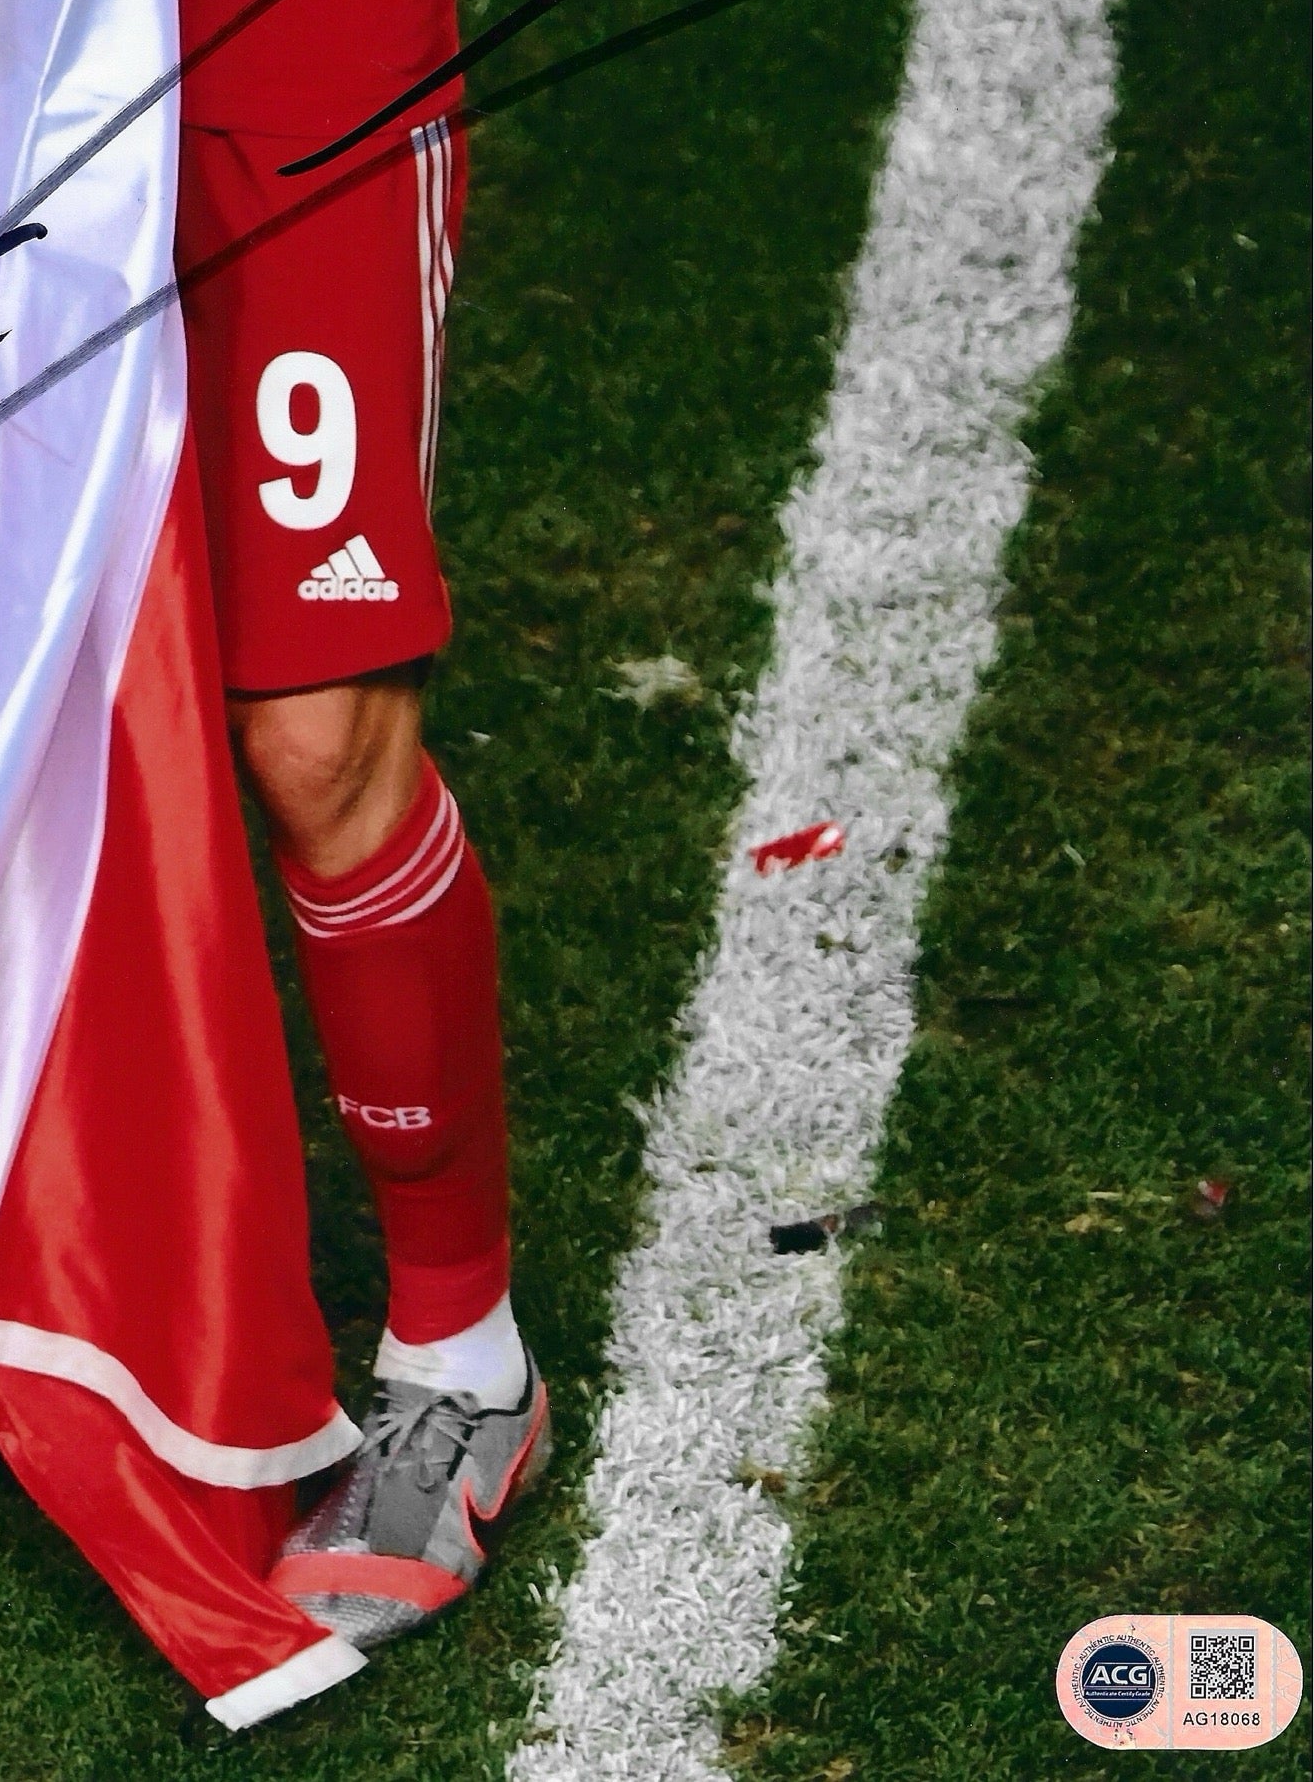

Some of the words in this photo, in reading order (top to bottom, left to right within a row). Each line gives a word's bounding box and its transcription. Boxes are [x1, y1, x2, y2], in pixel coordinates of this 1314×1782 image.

[255, 350, 358, 531] 9
[297, 576, 400, 601] adidas
[338, 1094, 432, 1130] FCB
[1079, 1634, 1115, 1661] AUTHENTIC
[1116, 1634, 1156, 1656] AUTHENTIC
[1071, 1663, 1086, 1708] AUTHENTIC
[1090, 1665, 1148, 1685] ACG
[1153, 1656, 1166, 1698] AUTHENTIC
[1125, 1699, 1160, 1727] AUTHENTIC
[1183, 1712, 1261, 1726] AG18068
